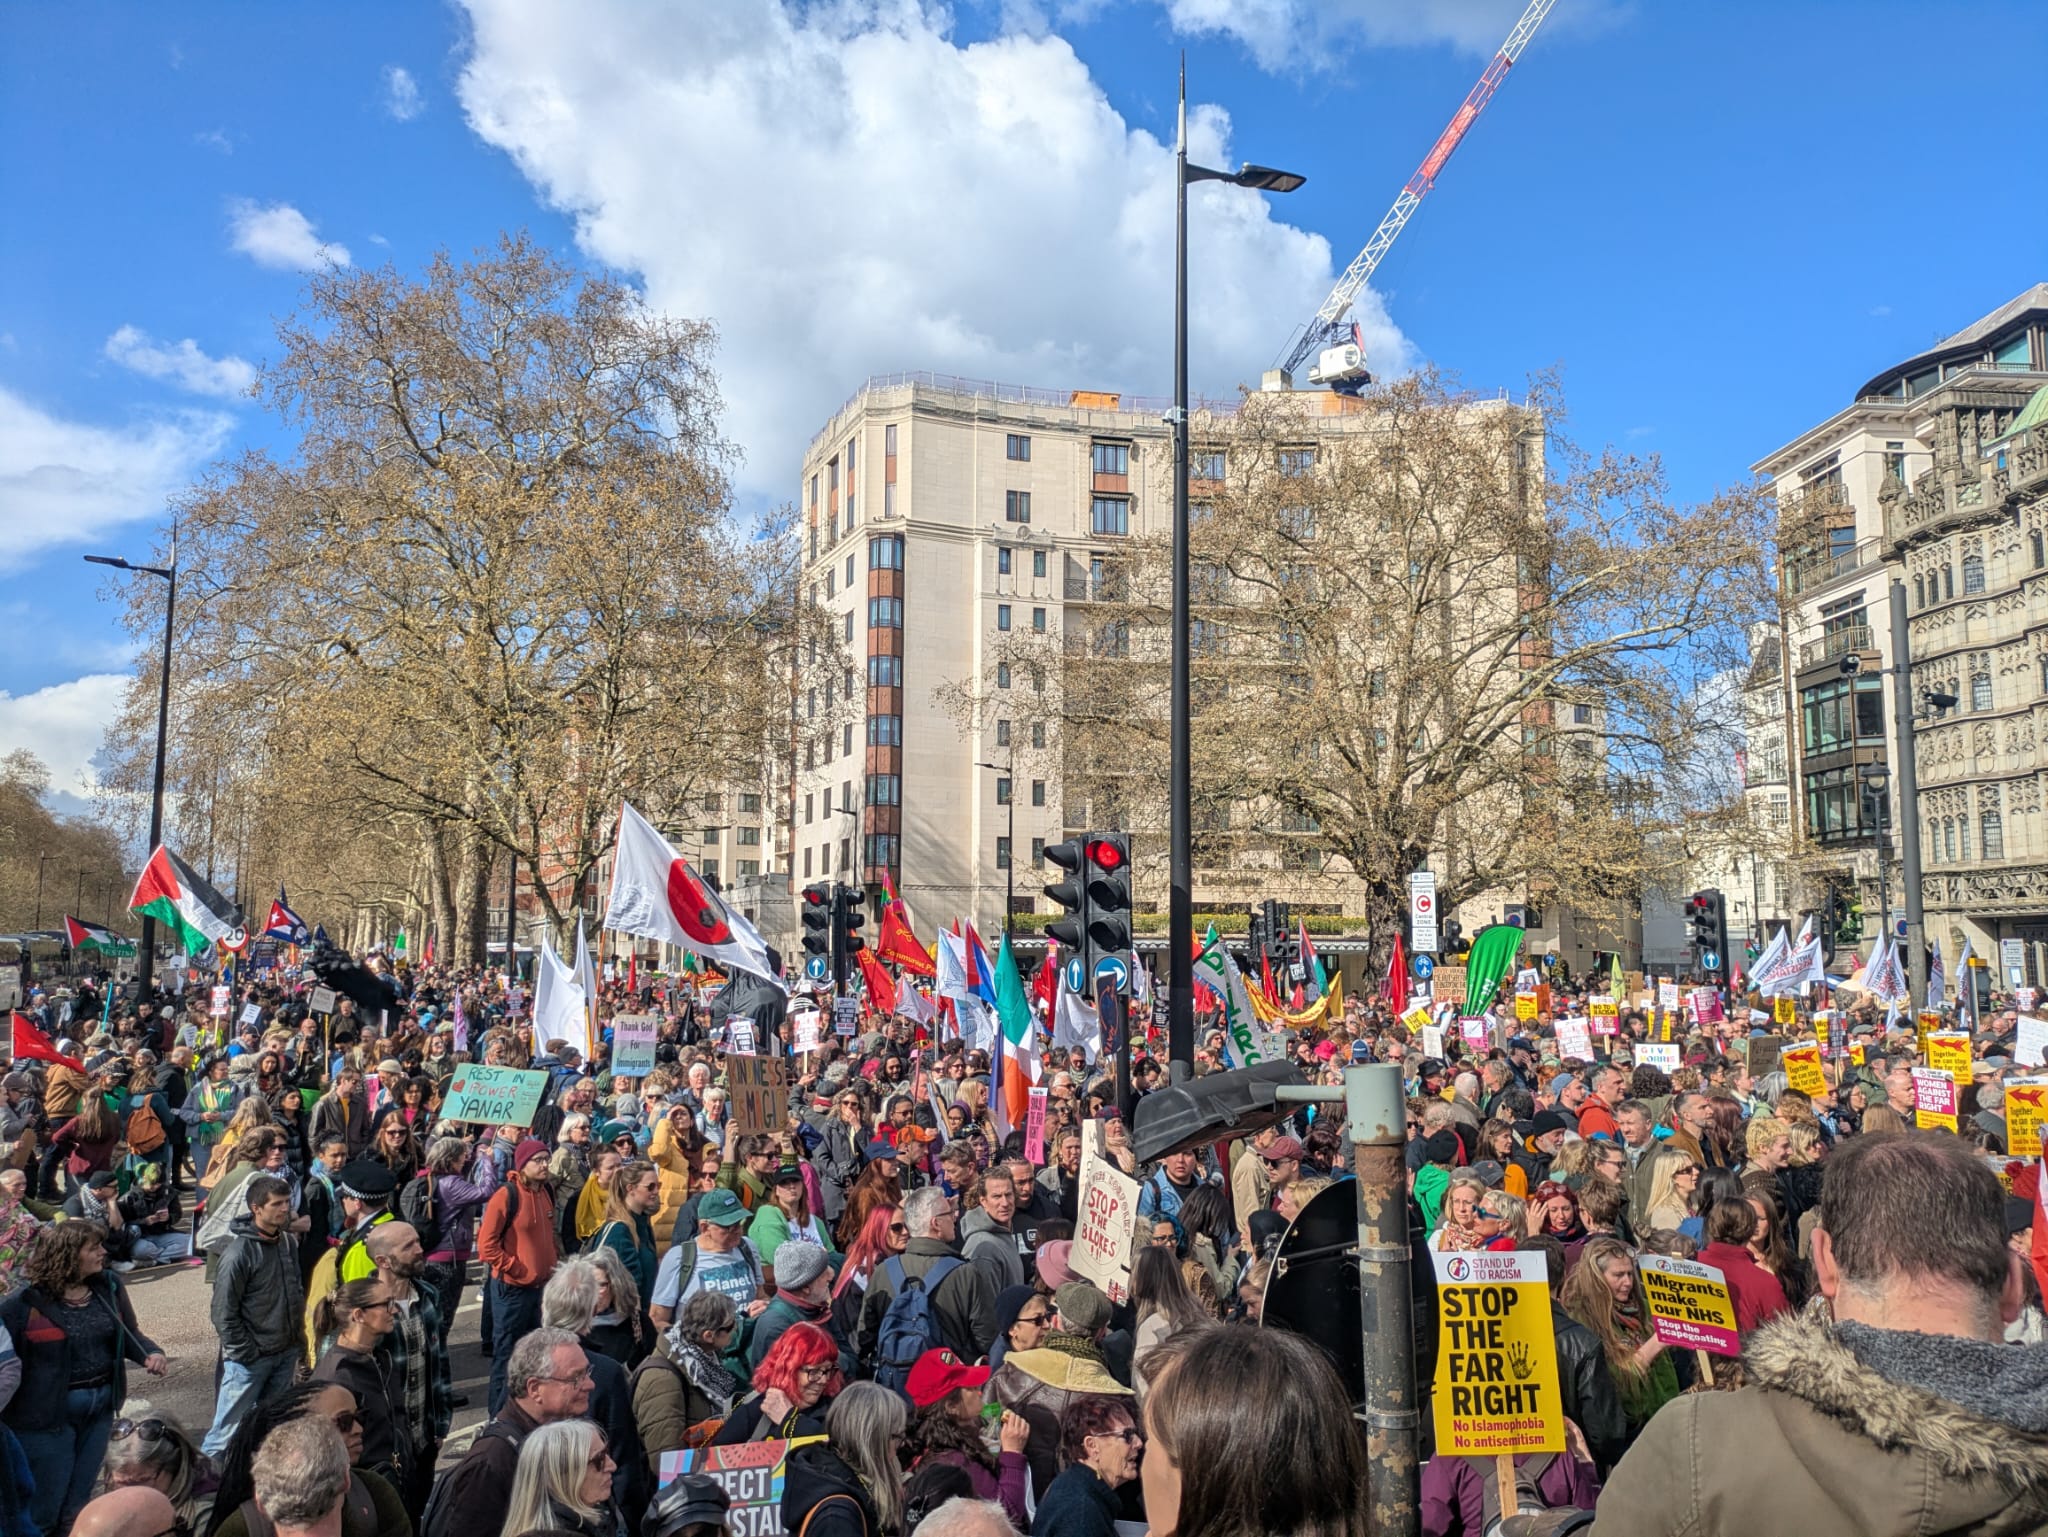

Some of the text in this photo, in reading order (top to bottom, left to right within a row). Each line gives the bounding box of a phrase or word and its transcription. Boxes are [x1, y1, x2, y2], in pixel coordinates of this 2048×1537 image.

[226, 928, 245, 941] 20
[621, 1021, 653, 1032] Thank God
[630, 1039, 641, 1050] For
[1933, 1050, 1957, 1058] Together
[616, 1057, 651, 1069] Immigrants
[1789, 1064, 1809, 1073] Together
[468, 1066, 526, 1084] REST IN
[729, 1057, 784, 1088] KINDNESS
[470, 1083, 520, 1099] POWER
[1916, 1078, 1948, 1089] WOMEN
[1918, 1087, 1952, 1098] AGAINST
[1918, 1094, 1951, 1105] THE FAR
[459, 1096, 514, 1120] YANAR
[1918, 1102, 1943, 1113] RIGHT
[2010, 1106, 2033, 1117] Together
[2030, 1128, 2041, 1137] rig
[1088, 1187, 1119, 1219] STOP
[1089, 1211, 1107, 1231] THE
[1081, 1223, 1116, 1258] BLOKES
[1472, 1257, 1516, 1269] STAND UP
[1672, 1262, 1693, 1271] STAND
[1473, 1268, 1522, 1279] TO RACISM
[1683, 1268, 1708, 1278] RACISM
[704, 1273, 753, 1293] Planet
[1646, 1272, 1725, 1298] Migrants
[731, 1288, 750, 1302] ver
[1442, 1286, 1519, 1318] STOP
[1650, 1290, 1698, 1307] make
[1654, 1303, 1725, 1325] our NHS
[1657, 1318, 1700, 1334] Stop the
[1445, 1319, 1505, 1350] THE
[1659, 1327, 1728, 1349] scapegoating
[1448, 1352, 1506, 1383] FAR
[1451, 1383, 1541, 1417] RIGHT
[1453, 1418, 1545, 1433] No Islamophobia
[1454, 1434, 1545, 1449] No antisemitism
